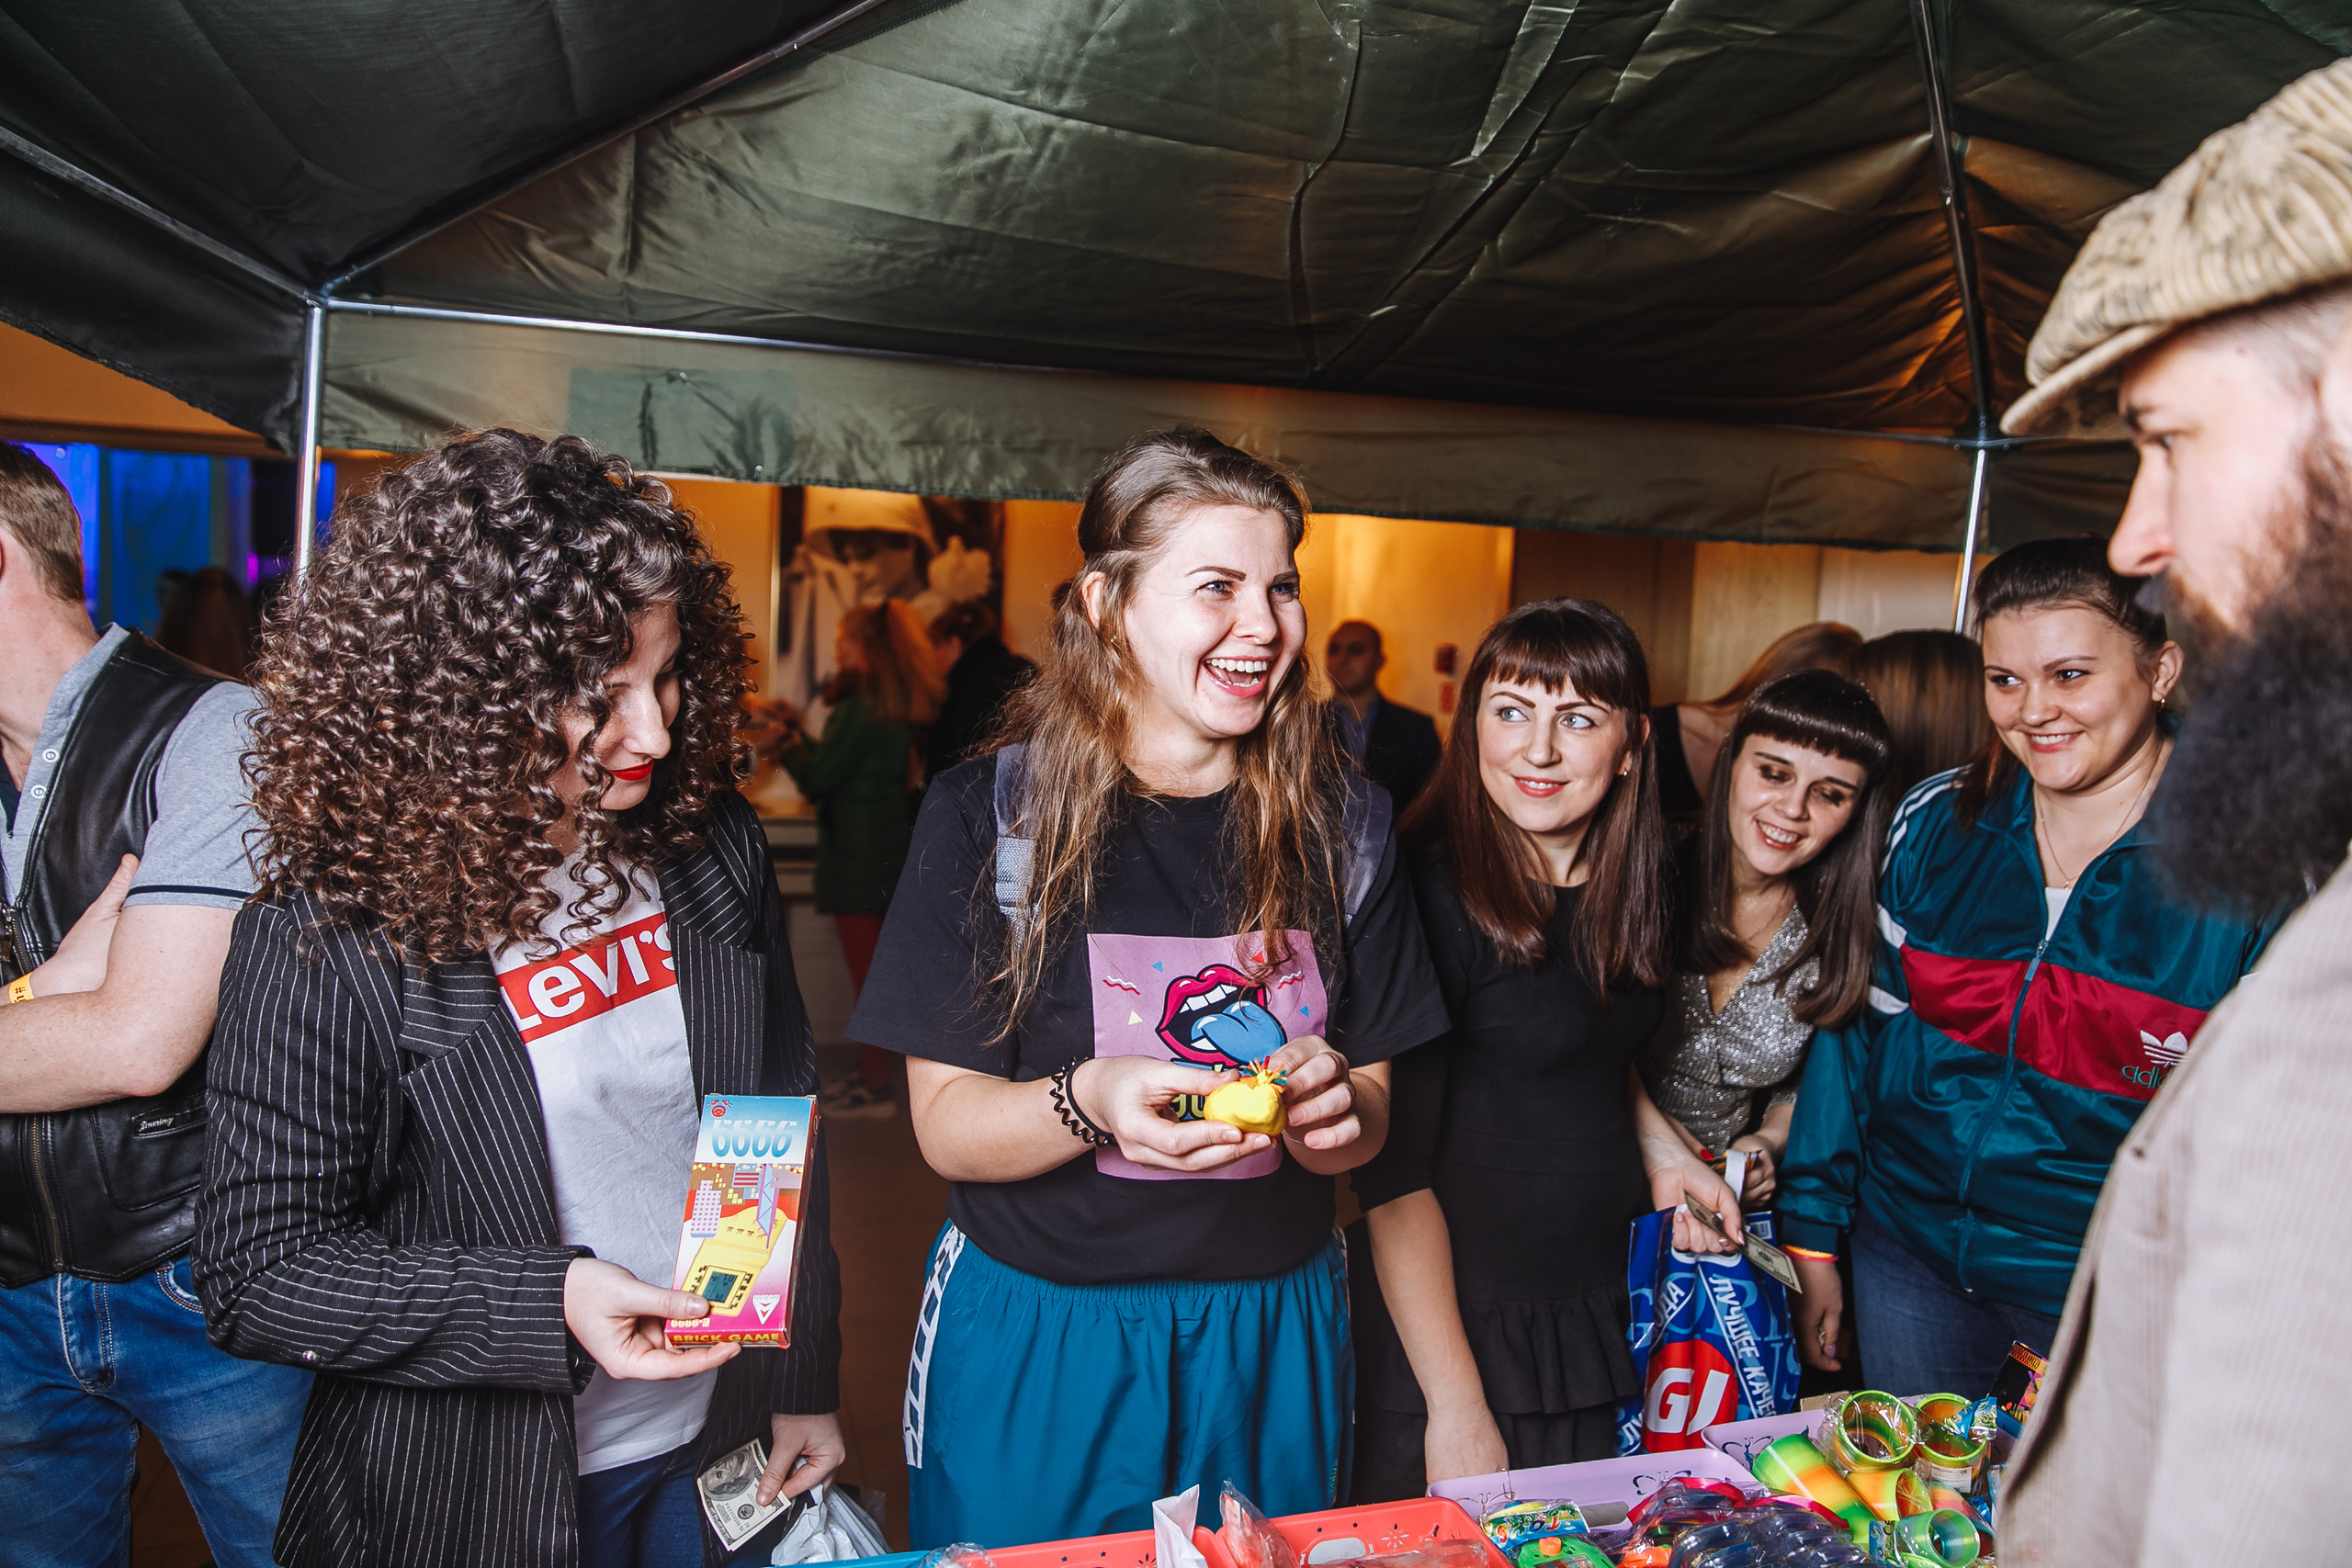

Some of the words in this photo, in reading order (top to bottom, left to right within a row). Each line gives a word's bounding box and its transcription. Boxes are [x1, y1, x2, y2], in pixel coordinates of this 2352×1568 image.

[1709, 1272, 1761, 1359] ЛУЧШЕЕ
[1645, 1367, 1729, 1436] GJ
[1497, 1516, 1560, 1543] TOYS
